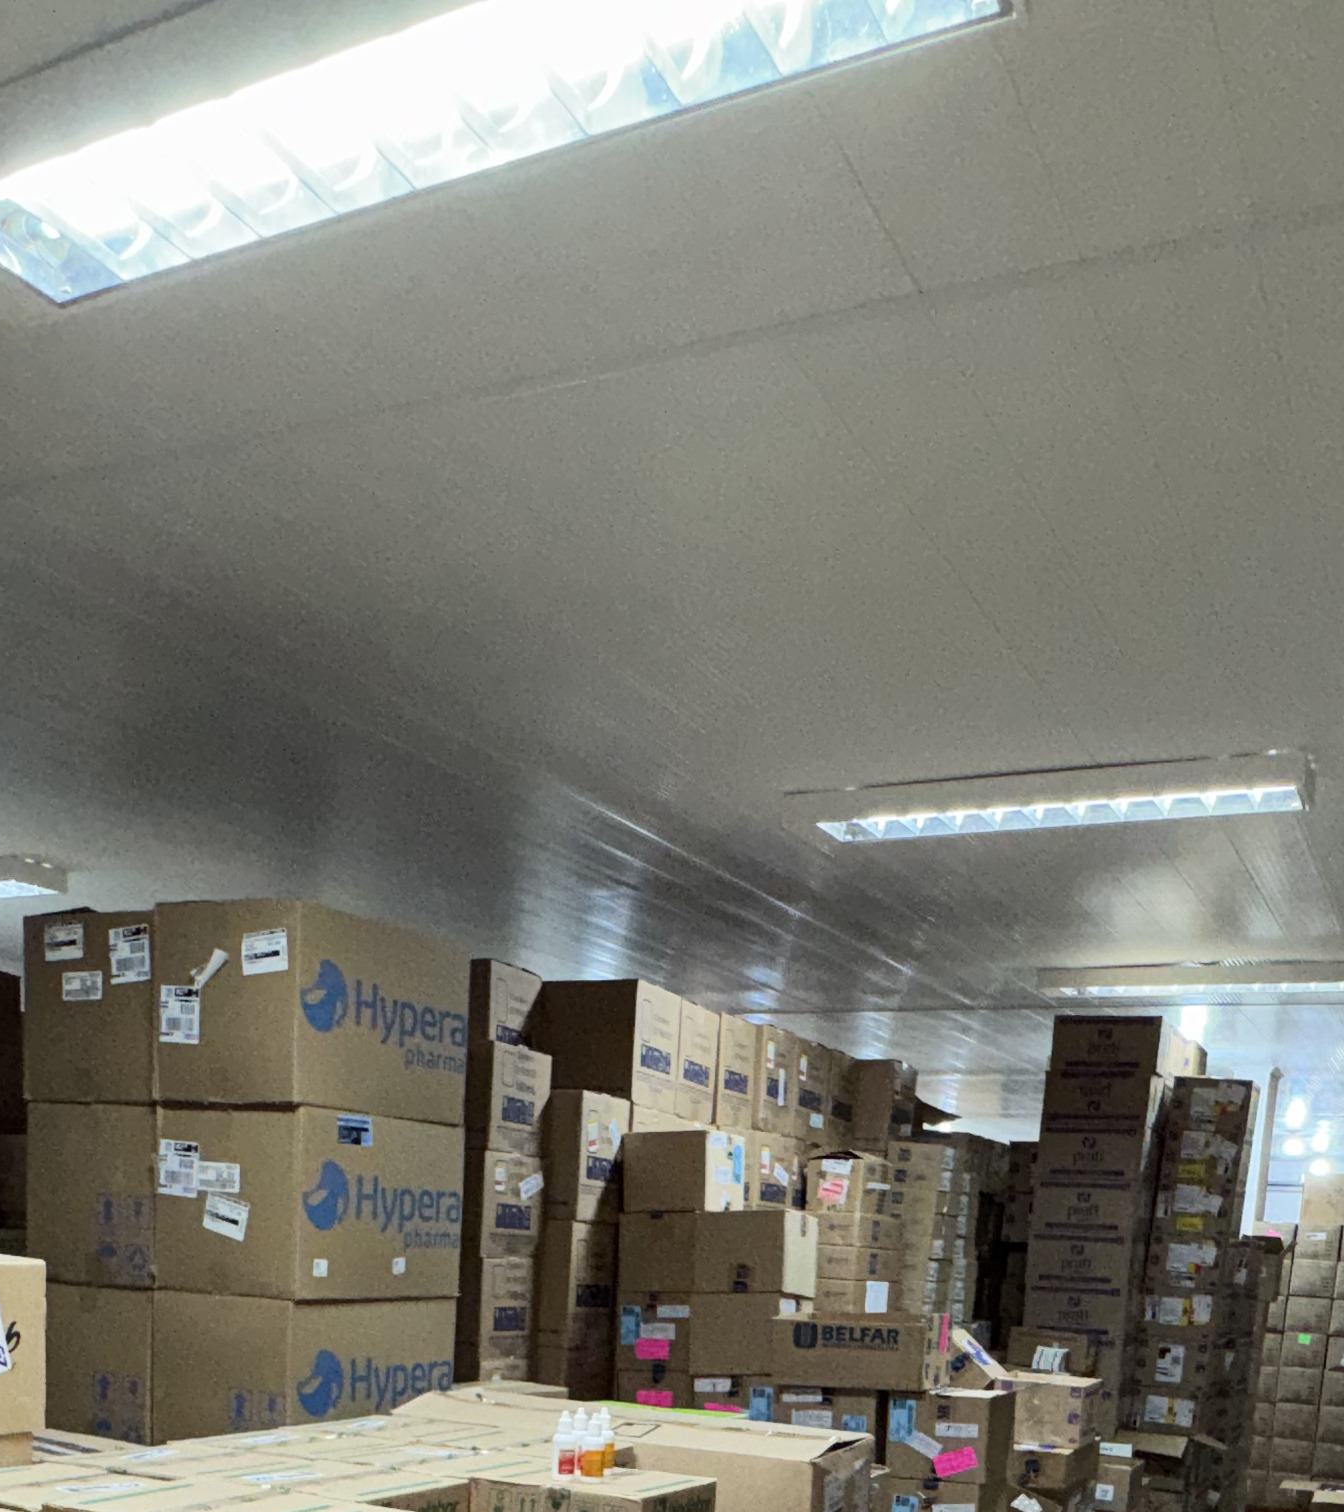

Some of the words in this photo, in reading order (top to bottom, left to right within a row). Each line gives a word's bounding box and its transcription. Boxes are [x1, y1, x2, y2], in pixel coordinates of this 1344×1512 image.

[354, 979, 466, 1047] Hypera
[354, 1174, 461, 1233] Hypera
[821, 1324, 900, 1346] BELFAR
[350, 1357, 453, 1402] Hypera
